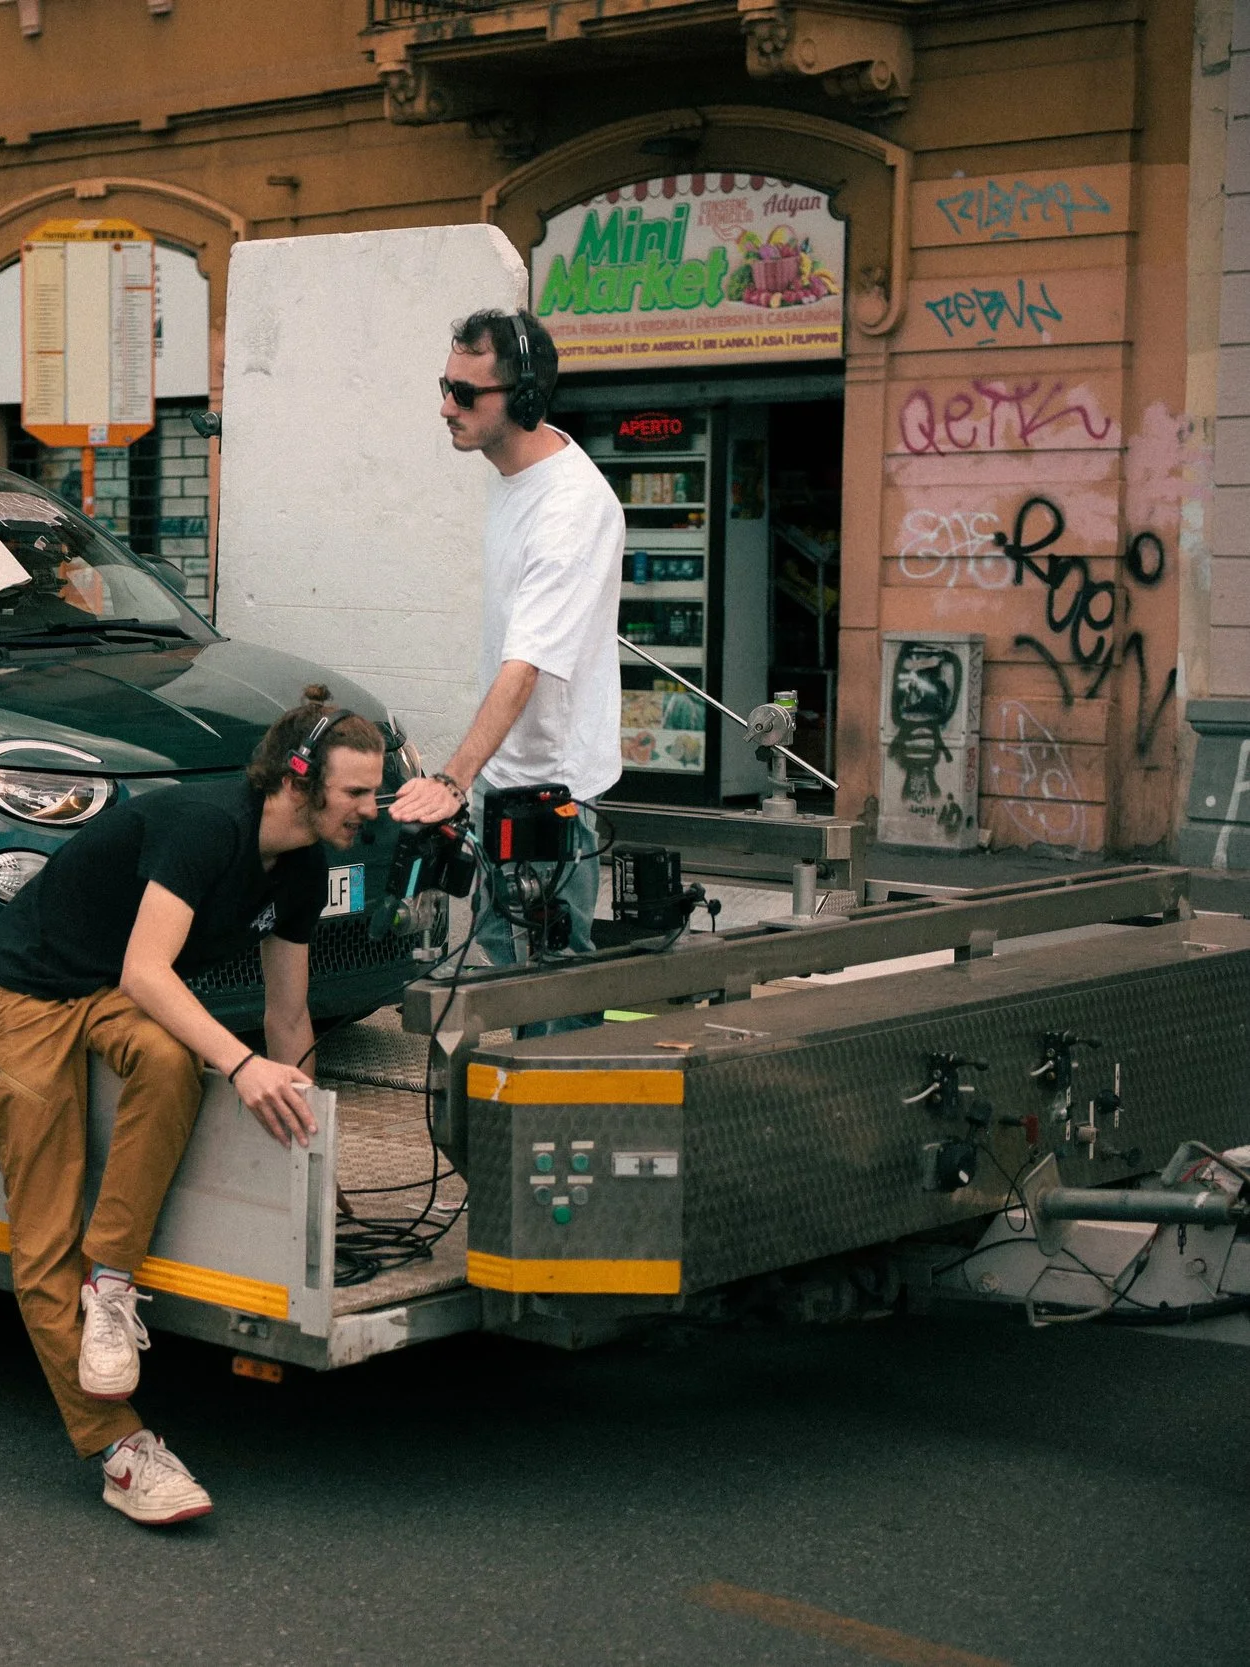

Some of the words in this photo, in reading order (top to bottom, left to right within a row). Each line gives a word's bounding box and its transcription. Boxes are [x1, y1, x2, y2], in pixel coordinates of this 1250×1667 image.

[763, 193, 822, 218] Adyan
[571, 202, 691, 266] Mini
[537, 246, 730, 317] Market
[548, 324, 577, 337] UTTA
[630, 342, 650, 353] SUD
[652, 340, 696, 352] AMERICA
[703, 338, 717, 350] SRI
[719, 337, 754, 349] LANKA
[761, 335, 784, 347] ASIA
[791, 332, 839, 345] FILIPPINE
[618, 418, 683, 436] APERTO
[330, 876, 348, 907] LF
